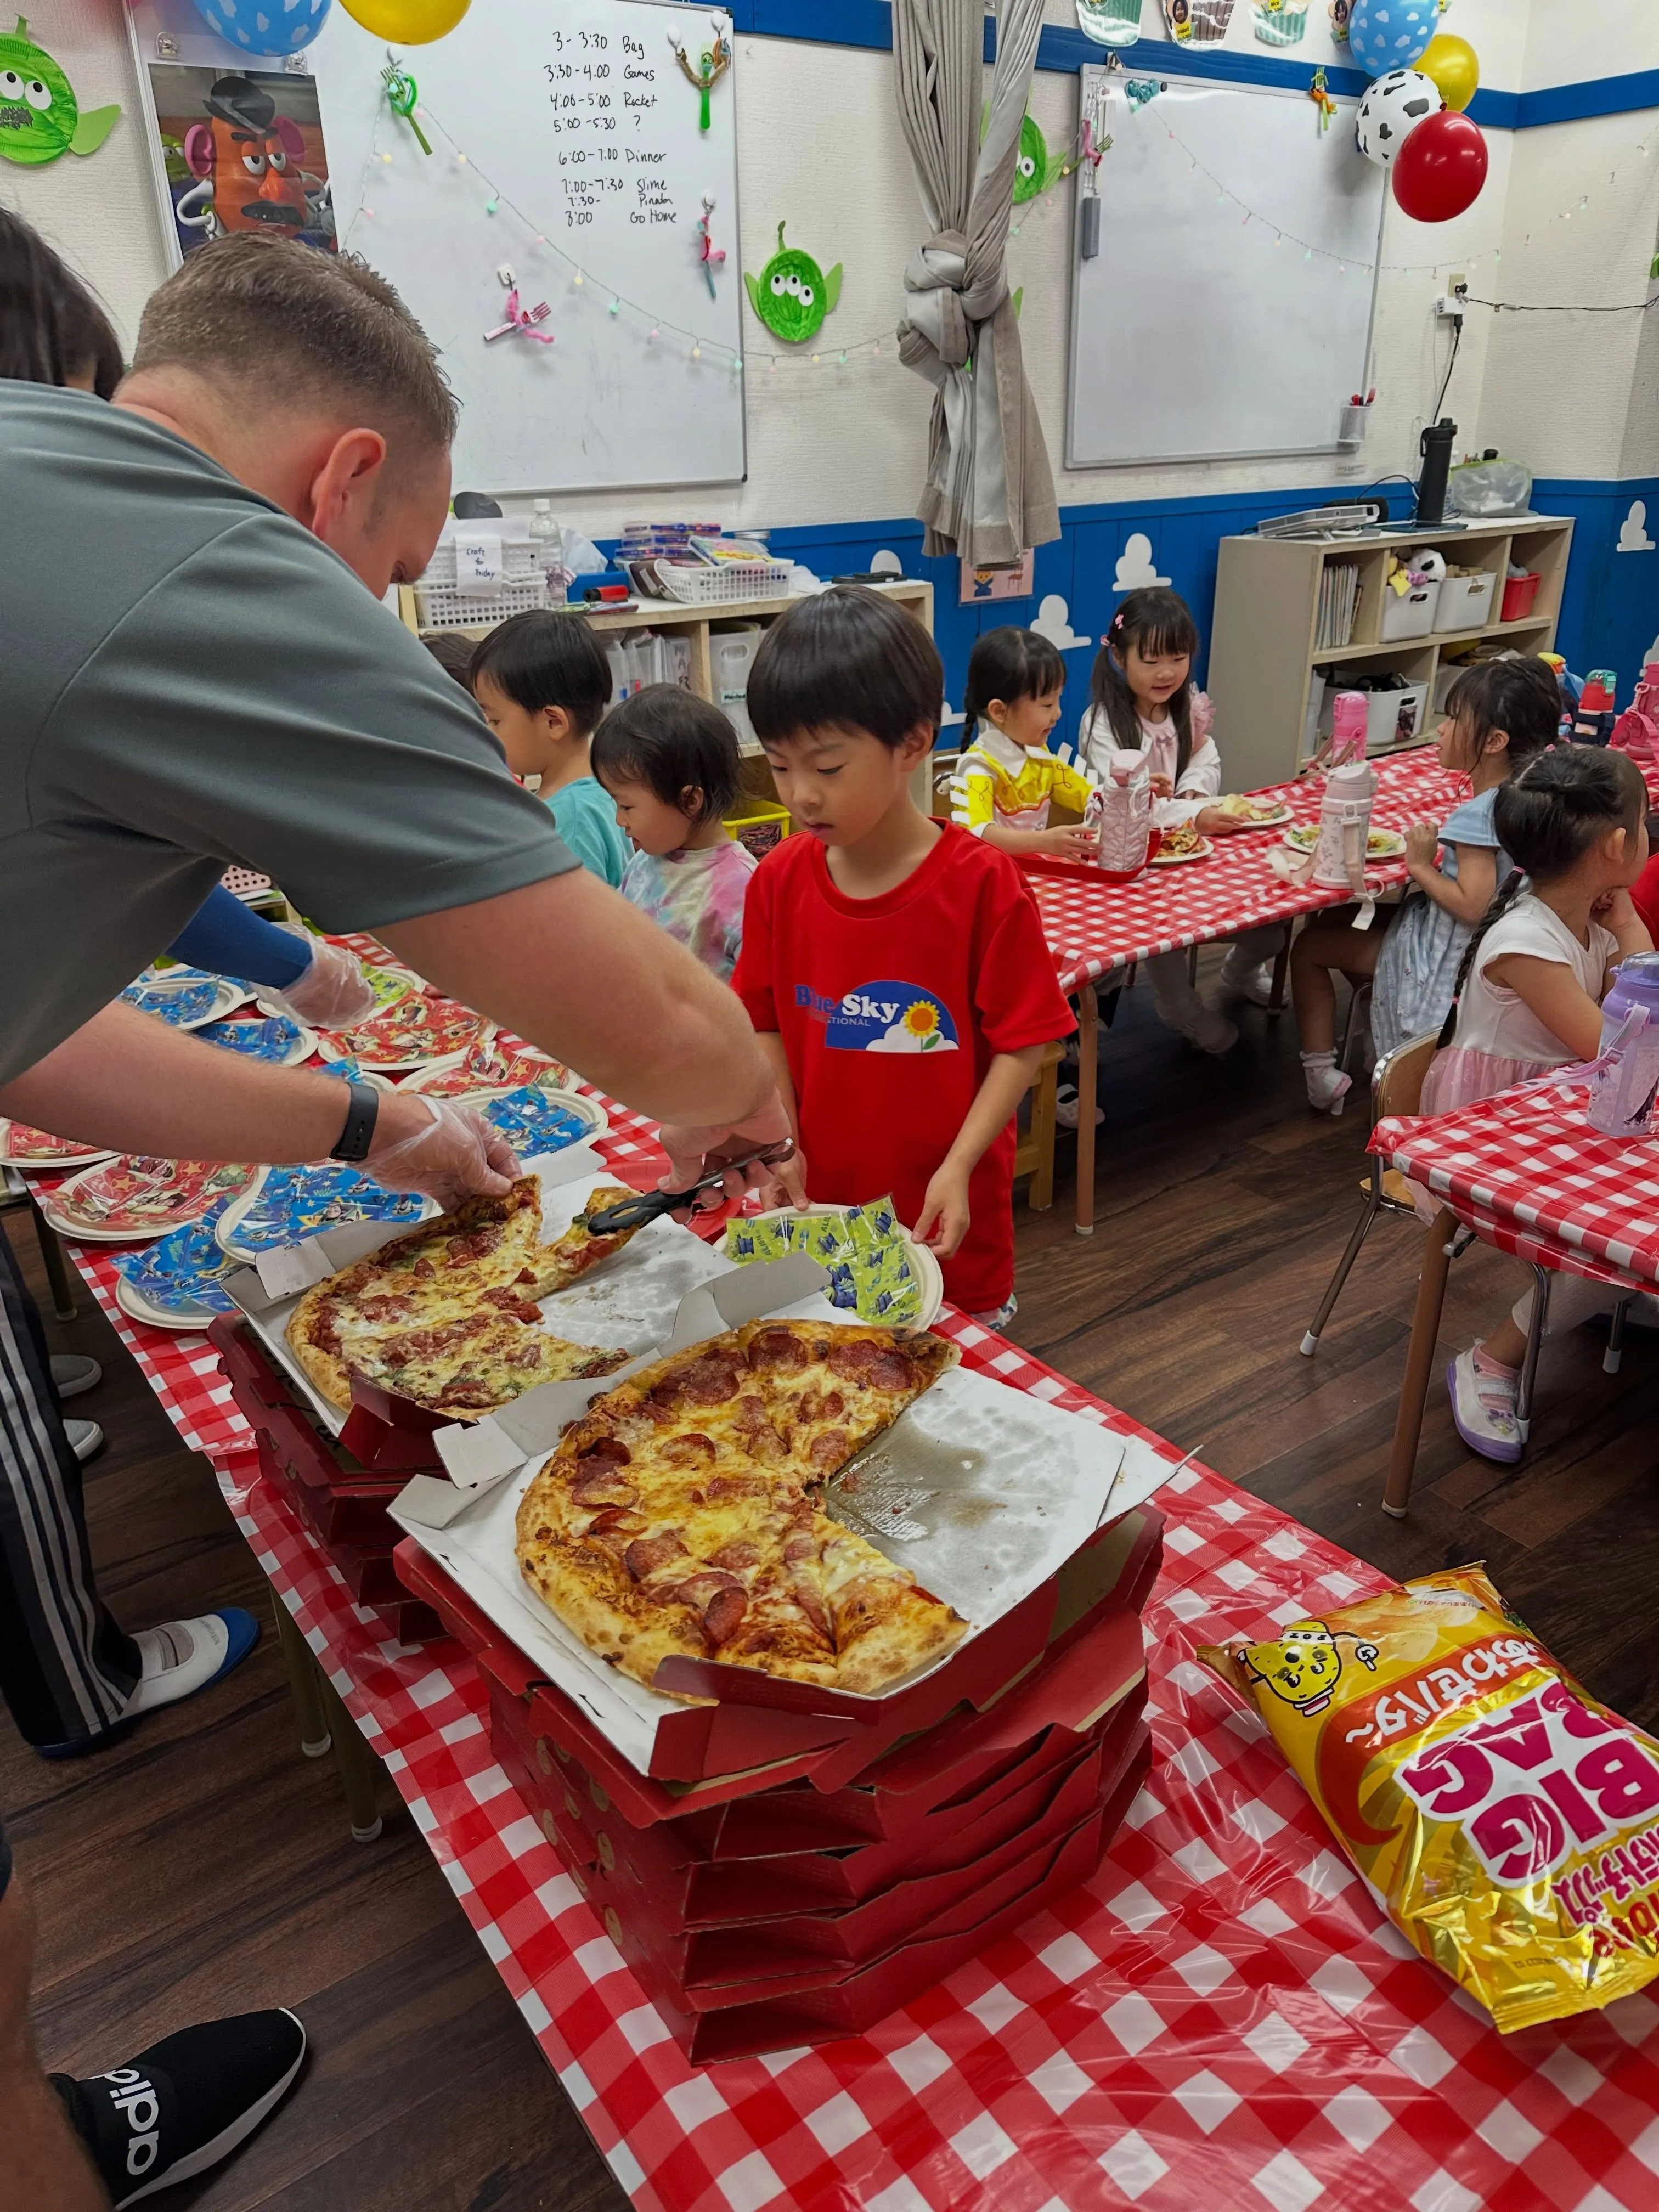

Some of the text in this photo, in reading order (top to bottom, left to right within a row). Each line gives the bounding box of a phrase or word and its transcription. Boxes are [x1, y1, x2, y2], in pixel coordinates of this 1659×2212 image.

[623, 36, 645, 60] Bag
[624, 67, 655, 81] Games
[624, 92, 658, 108] Rocket
[634, 115, 640, 132] ?
[625, 148, 667, 163] Dinner
[637, 177, 668, 192] Slime
[630, 211, 646, 224] Go
[650, 208, 677, 223] Home
[476, 567, 495, 581] Friday
[842, 994, 900, 1024] Sky
[1289, 1633, 1327, 1641] POT
[1401, 1681, 1629, 1814] BAG
[1471, 1738, 1659, 1880] BIG
[87, 2068, 159, 2175] adid
